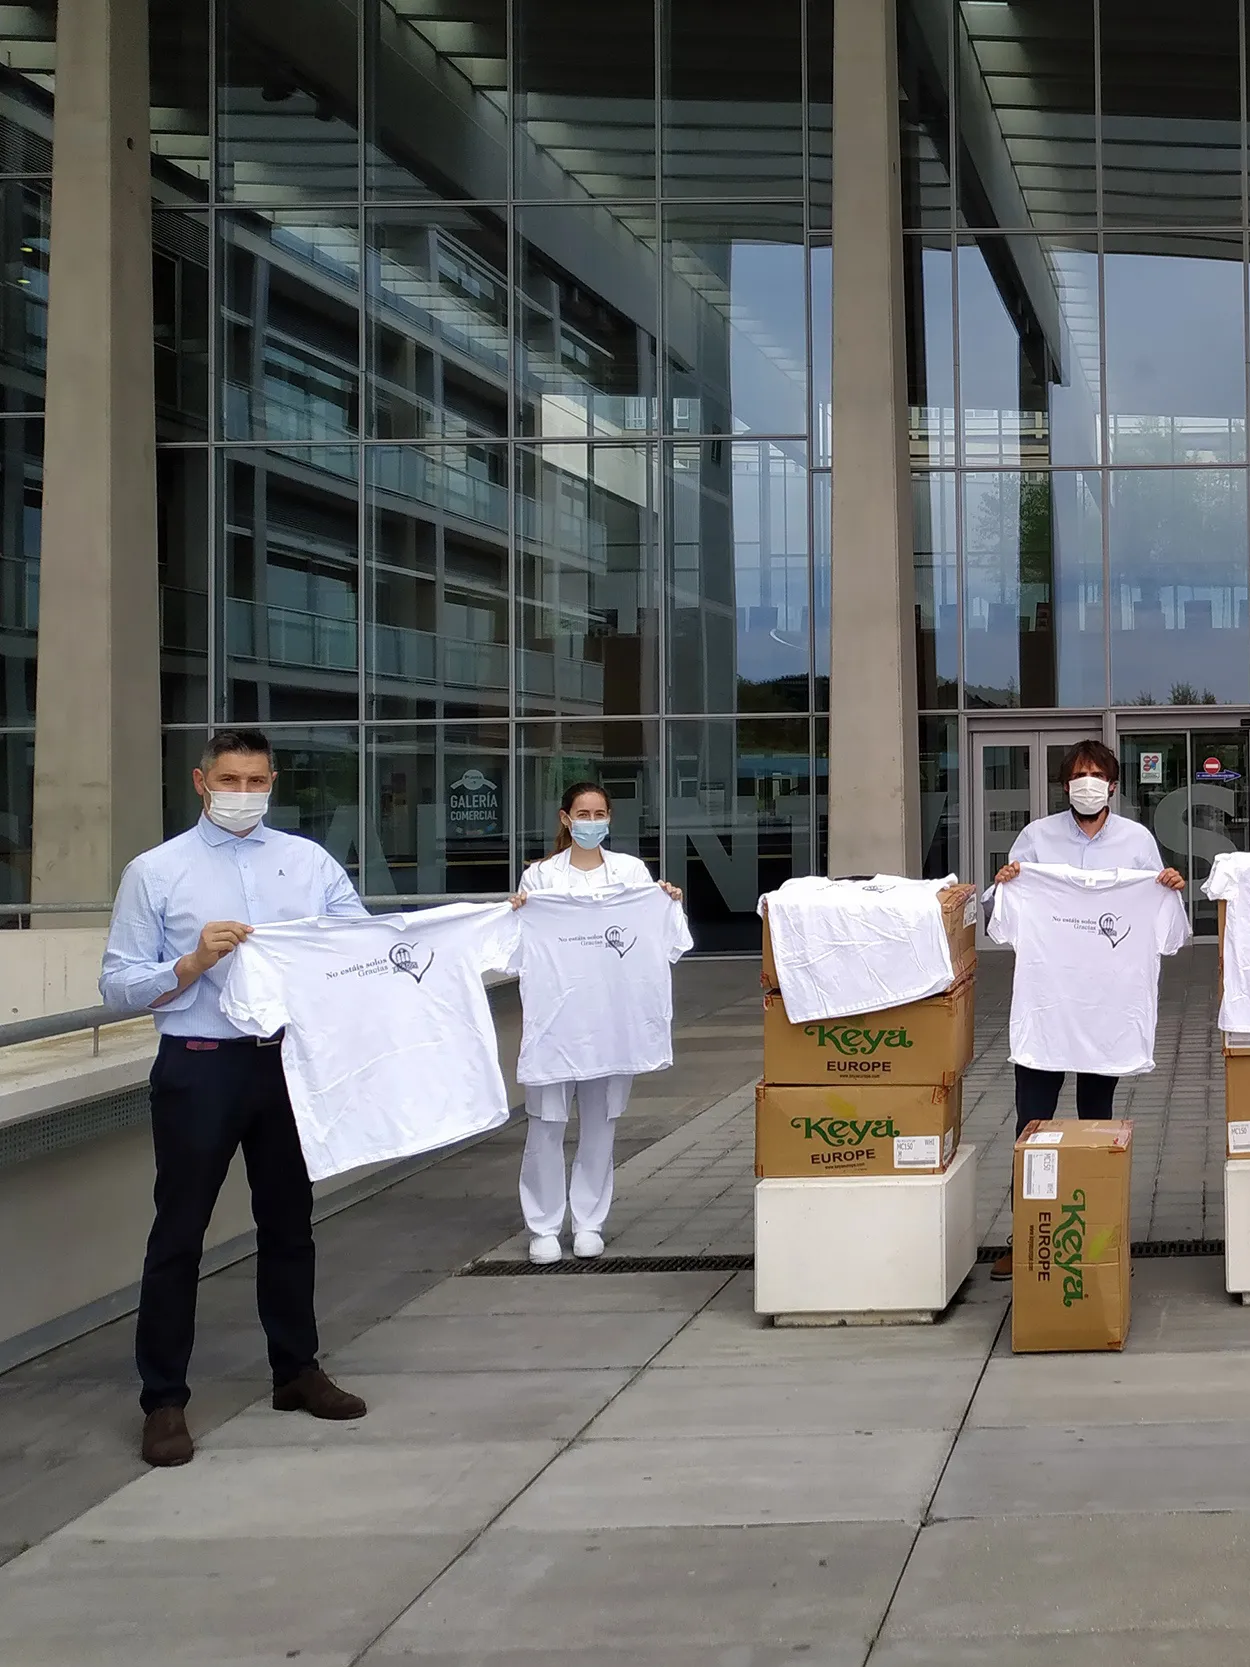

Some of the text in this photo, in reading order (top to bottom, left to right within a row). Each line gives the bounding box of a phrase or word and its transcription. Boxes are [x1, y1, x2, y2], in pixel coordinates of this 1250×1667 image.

[450, 792, 498, 808] GALERÍA
[450, 810, 498, 821] COMERCIAL
[326, 971, 339, 980] No
[340, 963, 364, 976] estáis
[366, 957, 387, 969] solos
[357, 965, 388, 978] Gracias
[827, 1061, 891, 1072] EUROPE
[810, 1148, 876, 1164] EUROPE
[1038, 1212, 1051, 1281] EUROPE
